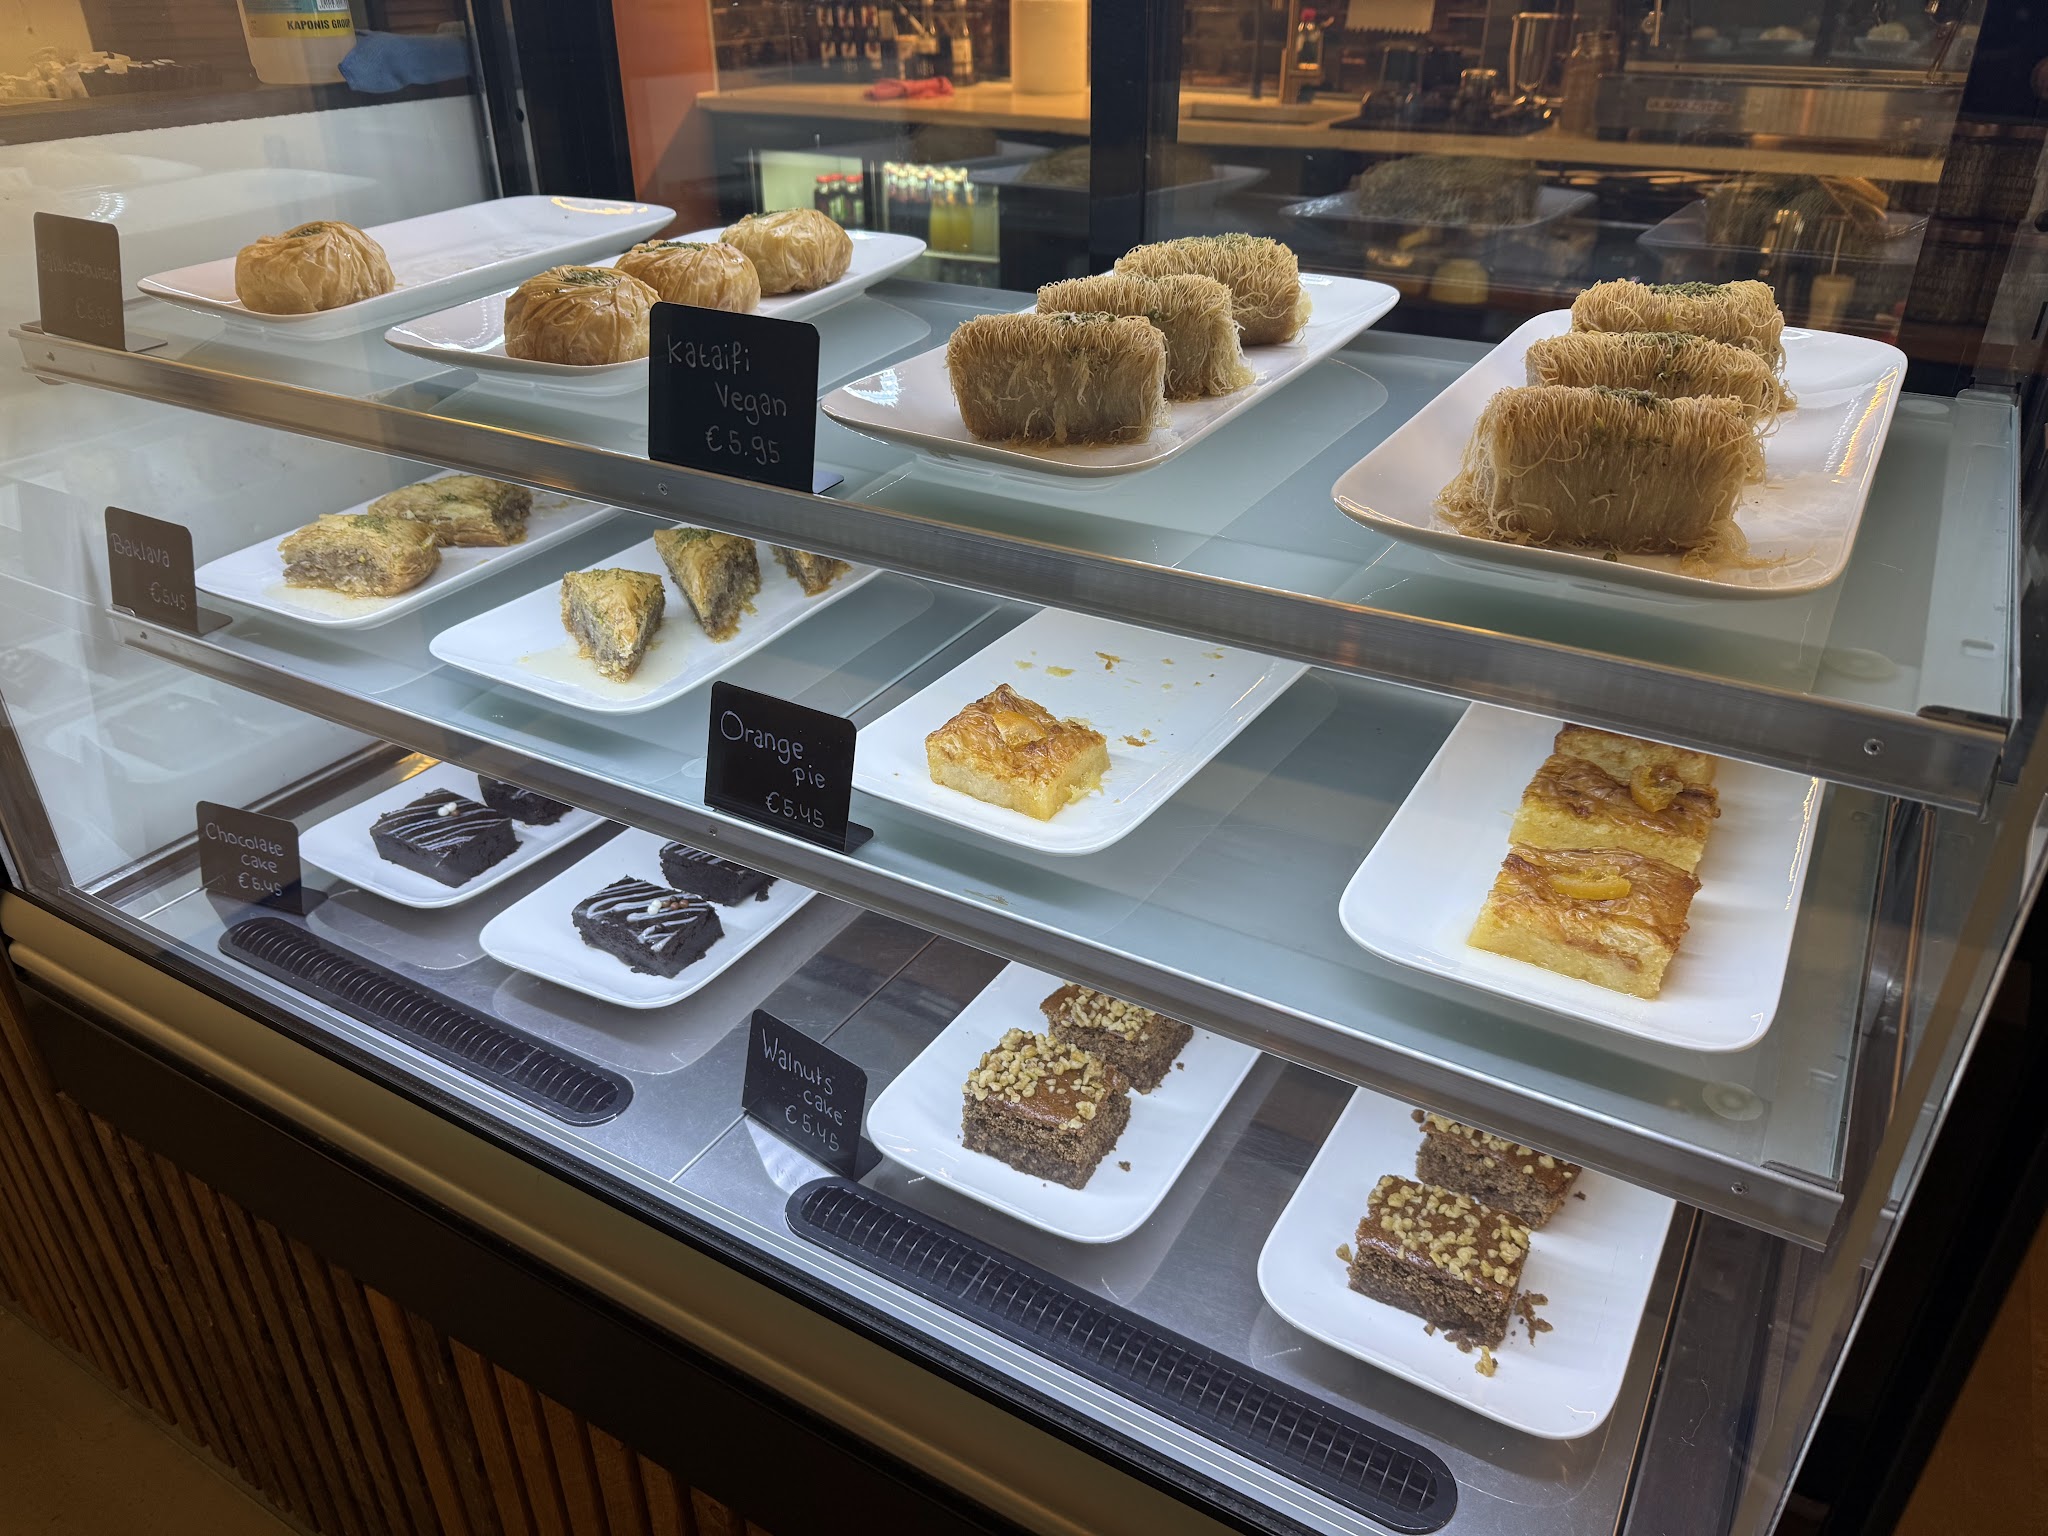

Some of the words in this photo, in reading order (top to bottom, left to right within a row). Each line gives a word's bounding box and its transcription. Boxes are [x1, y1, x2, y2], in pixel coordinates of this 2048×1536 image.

[286, 19, 330, 31] KAPONIS
[714, 381, 787, 426] Vegan
[705, 425, 780, 465] €5.95
[110, 532, 170, 568] Baklava
[149, 581, 187, 611] €5.45
[720, 710, 804, 765] Orange
[792, 764, 826, 789] pie
[765, 791, 825, 829] €5.45
[205, 822, 284, 857] Chocolate
[240, 854, 278, 874] cake
[762, 1028, 833, 1095] Walnuts
[803, 1090, 843, 1126] cake
[785, 1104, 840, 1151] €5.45
